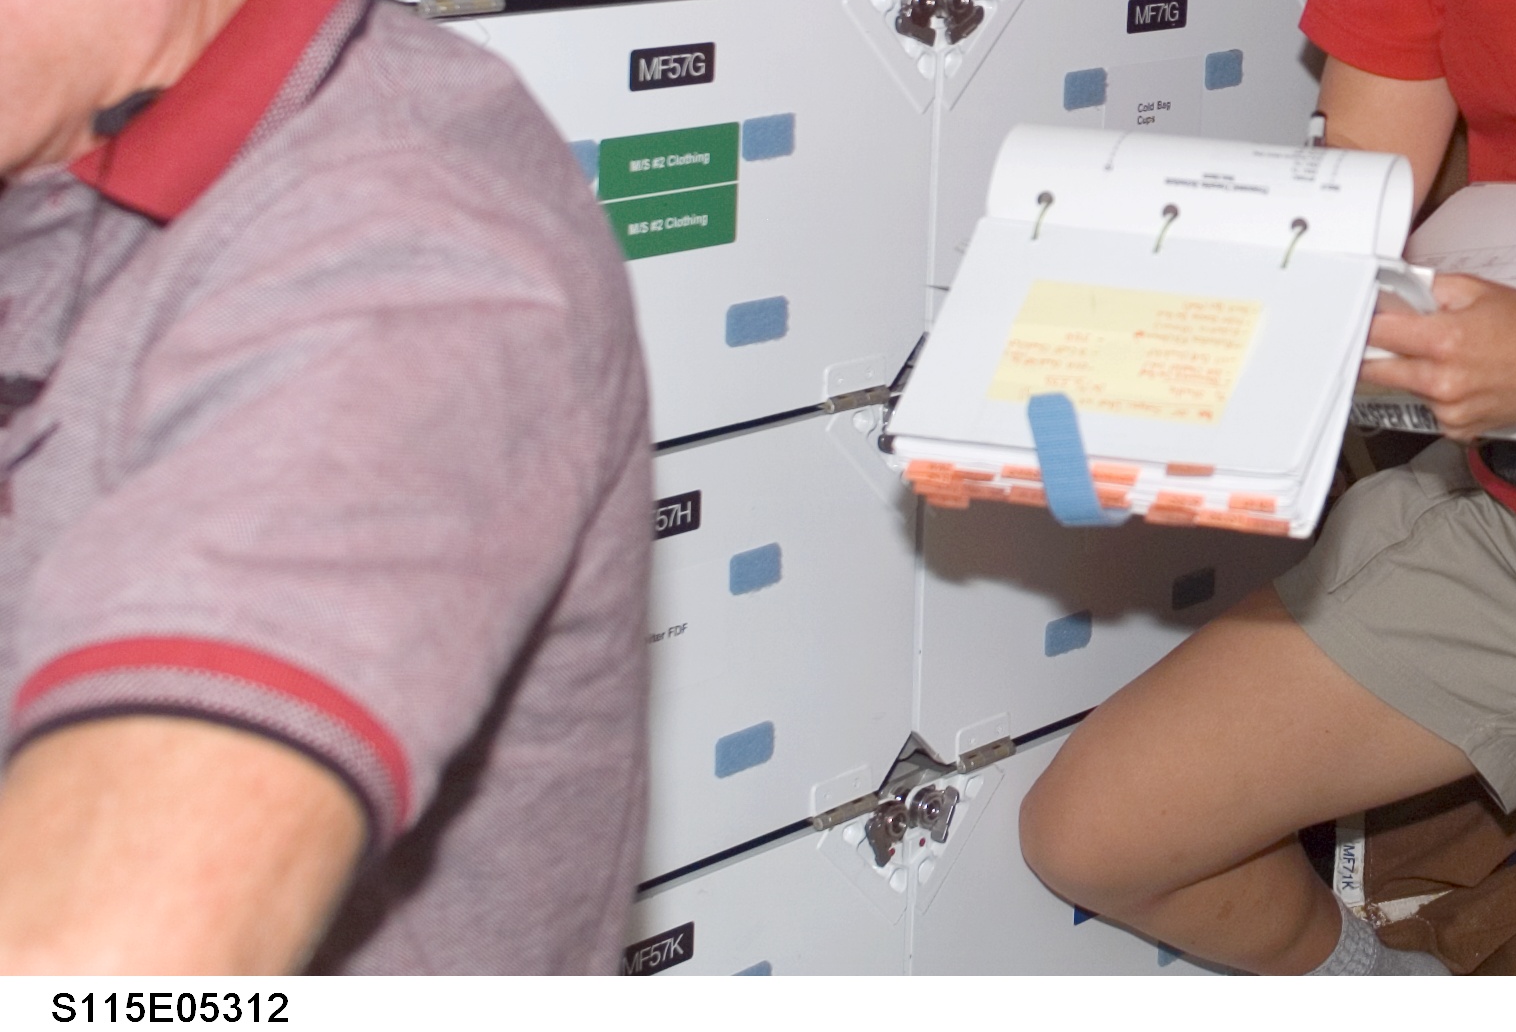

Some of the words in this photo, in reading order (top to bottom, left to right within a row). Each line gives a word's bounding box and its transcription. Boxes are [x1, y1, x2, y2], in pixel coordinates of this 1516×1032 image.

[1135, 1, 1180, 25] MF71G
[638, 51, 706, 82] MF57G
[1137, 102, 1155, 113] Cold
[1157, 100, 1172, 111] Bag
[1137, 115, 1155, 126] Cups
[629, 158, 651, 172] M/S
[652, 156, 666, 170] #2
[666, 151, 711, 168] Clothing
[627, 221, 649, 235] M/S
[650, 218, 664, 232] #2
[664, 214, 709, 230] Clothing
[655, 500, 692, 532] 57H
[667, 622, 689, 639] FDF
[1341, 844, 1356, 890] MF71K
[622, 932, 685, 976] MF57K
